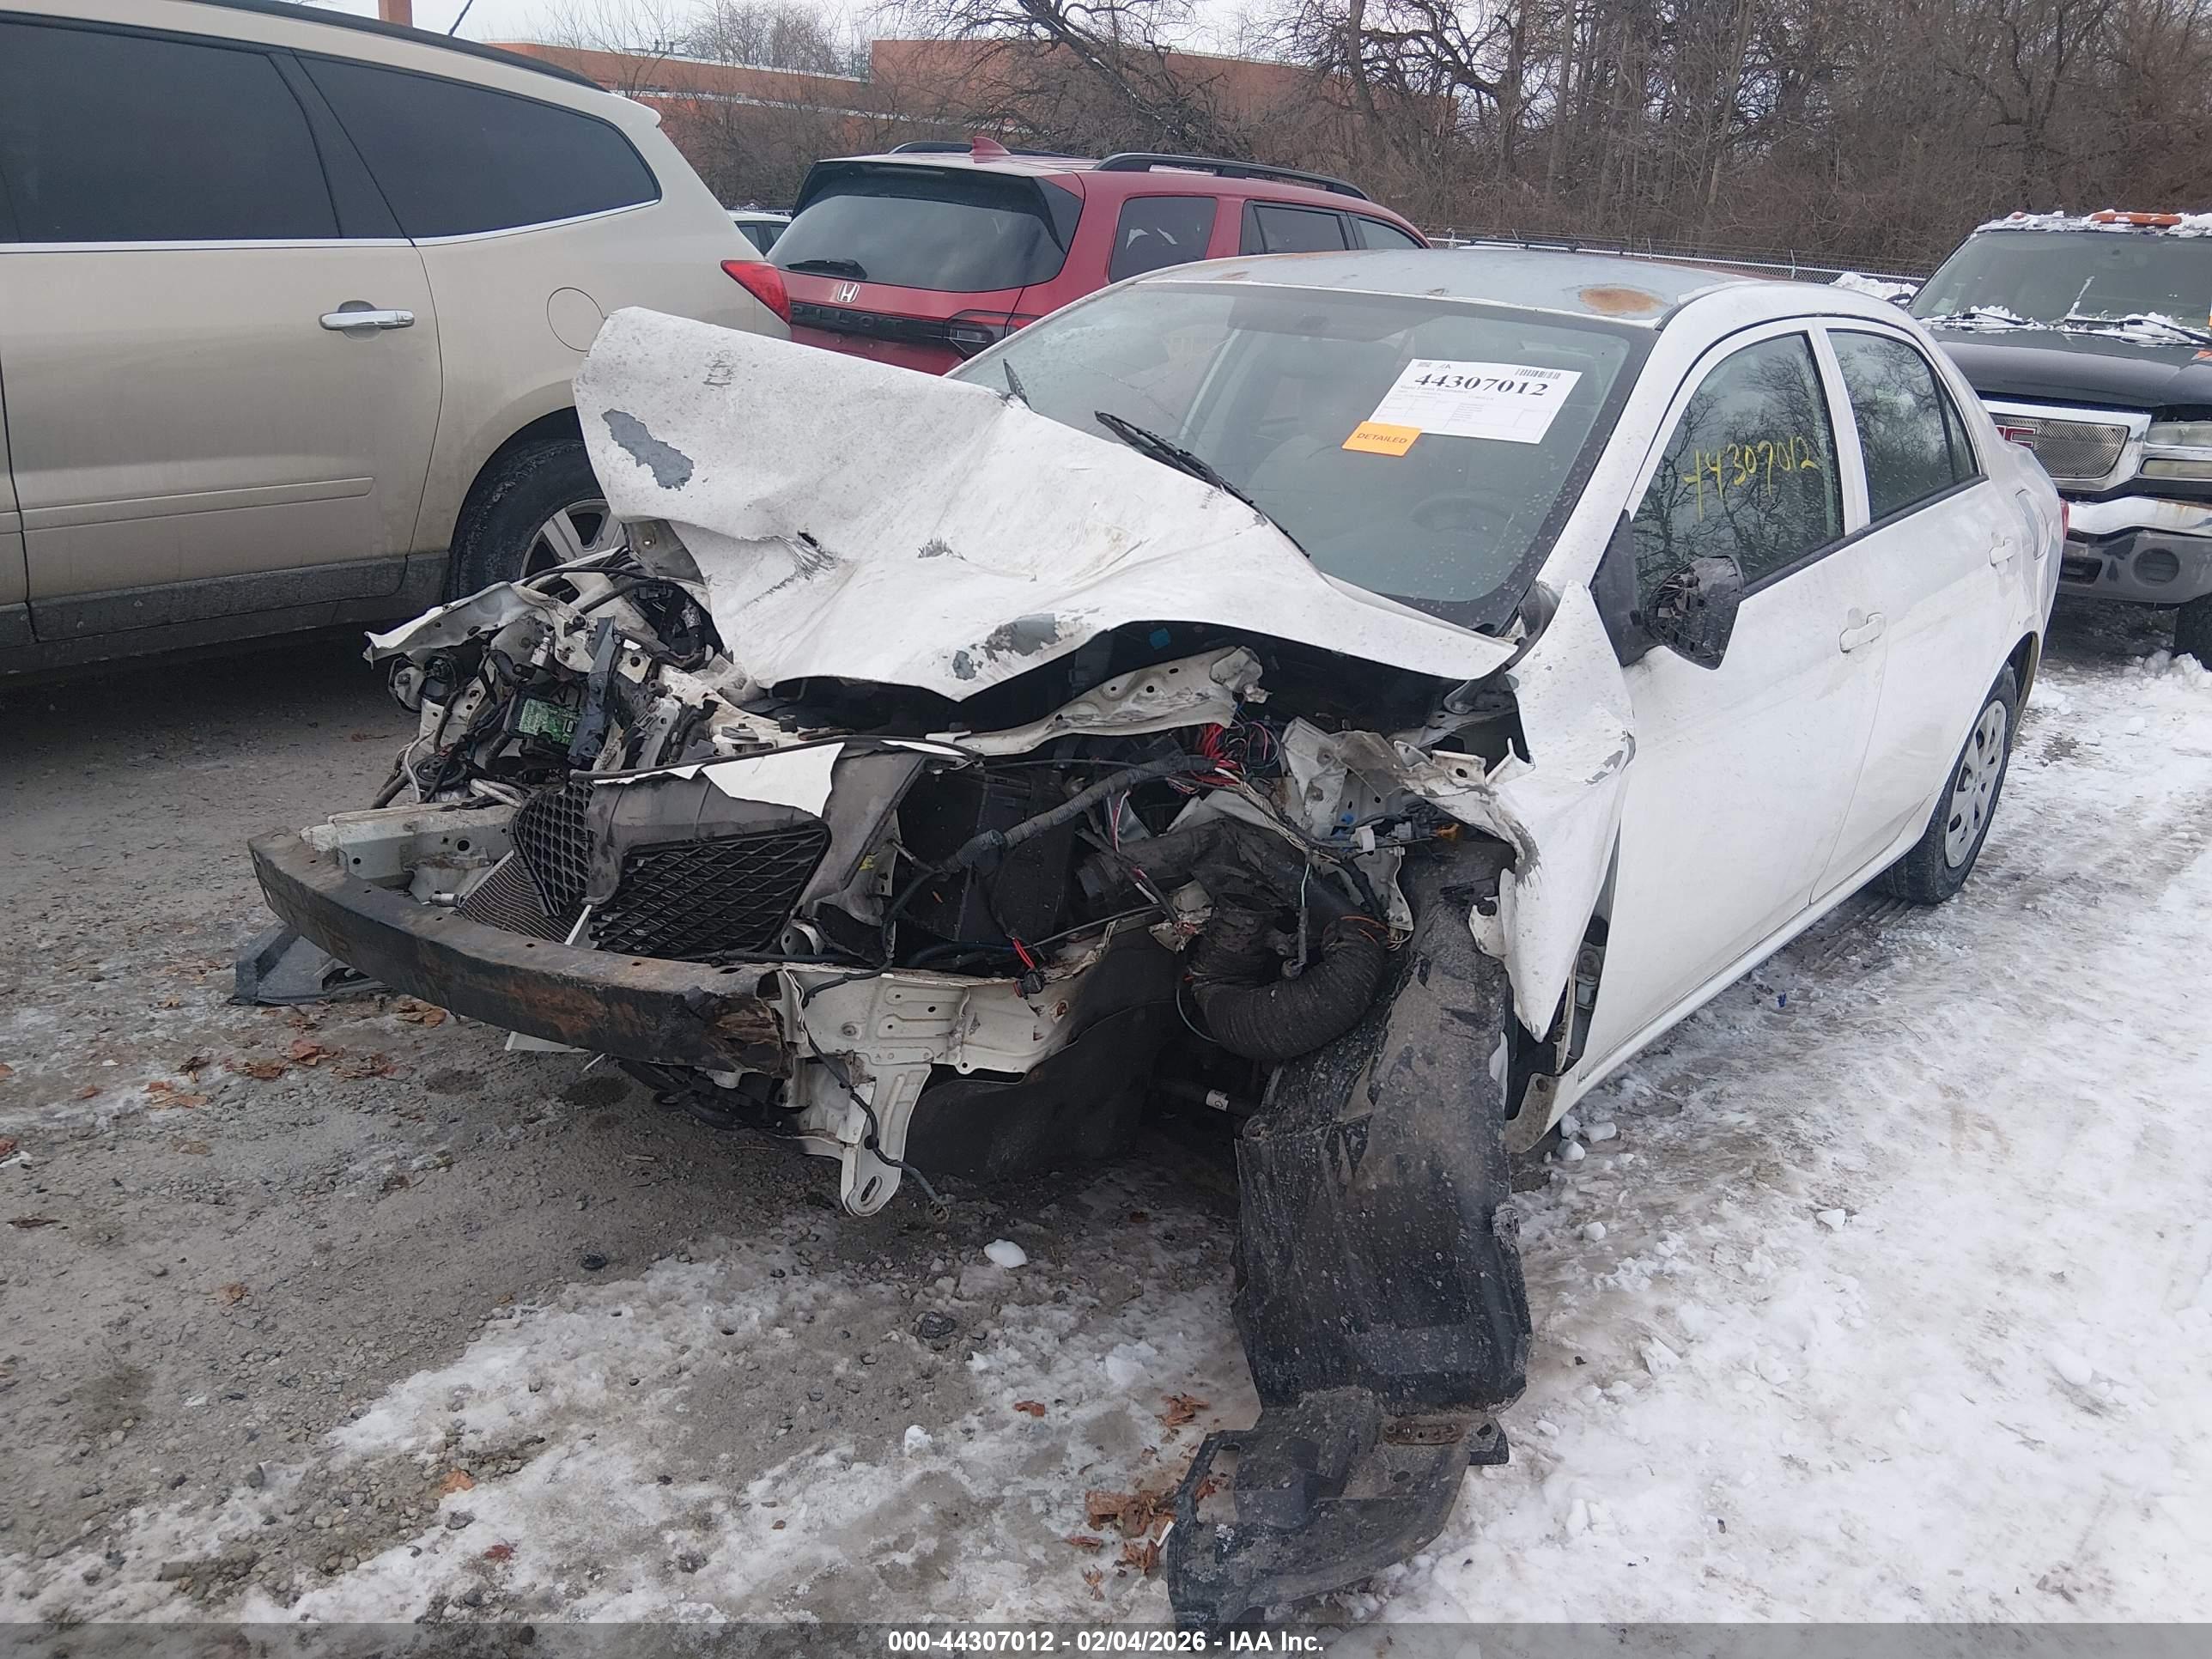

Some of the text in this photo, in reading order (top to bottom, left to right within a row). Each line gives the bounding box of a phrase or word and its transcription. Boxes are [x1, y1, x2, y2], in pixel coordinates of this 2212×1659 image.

[1413, 373, 1549, 396] 44307012
[1356, 432, 1408, 444] DETAILED
[1683, 435, 1824, 523] 44307012
